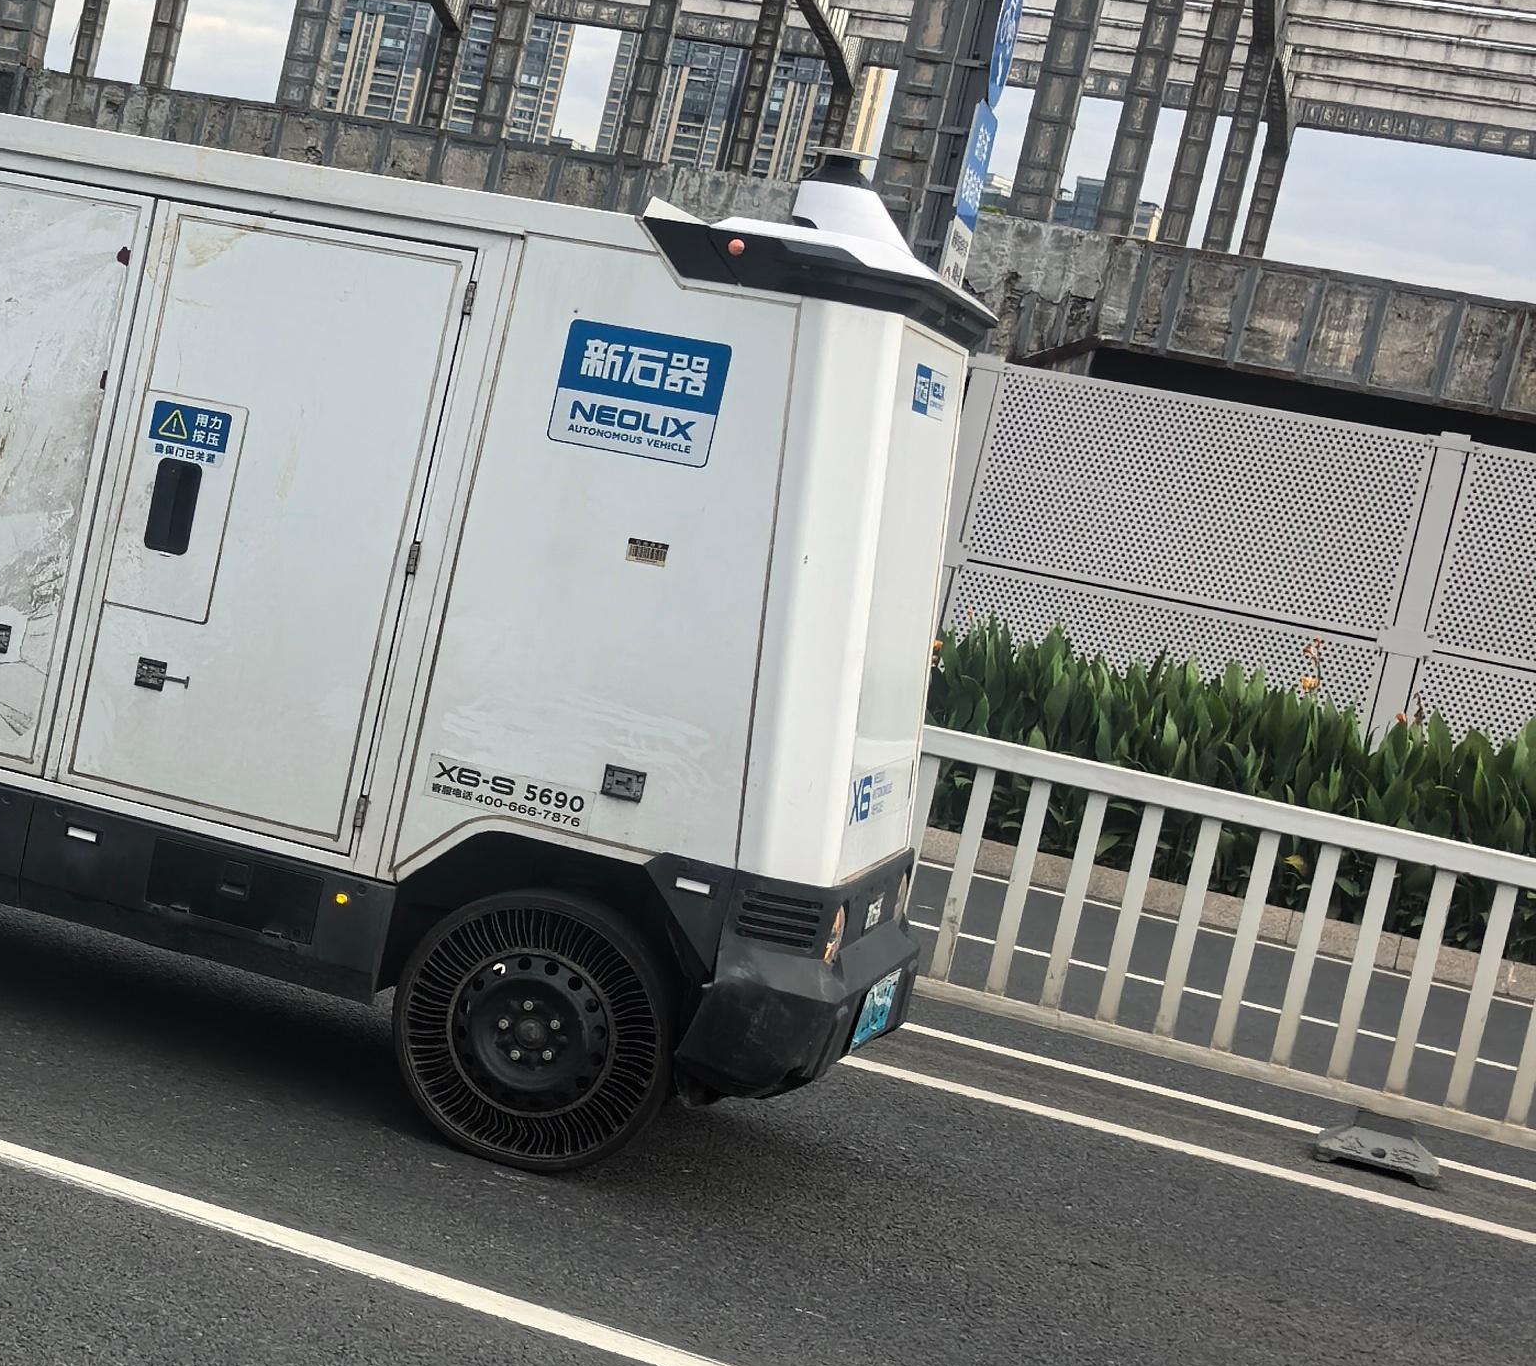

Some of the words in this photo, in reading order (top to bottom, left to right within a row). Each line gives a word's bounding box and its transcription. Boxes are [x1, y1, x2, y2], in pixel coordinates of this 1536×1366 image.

[580, 338, 710, 397] 新石器
[192, 428, 221, 447] 按压
[195, 413, 223, 430] 用力
[567, 423, 643, 445] AUTONOMOUS
[646, 437, 692, 454] VEHICLE
[569, 400, 696, 442] NEOLIX
[434, 761, 516, 796] X6-S
[523, 783, 585, 813] 5690
[848, 775, 873, 826] X6
[475, 793, 581, 827] 400-666-7876
